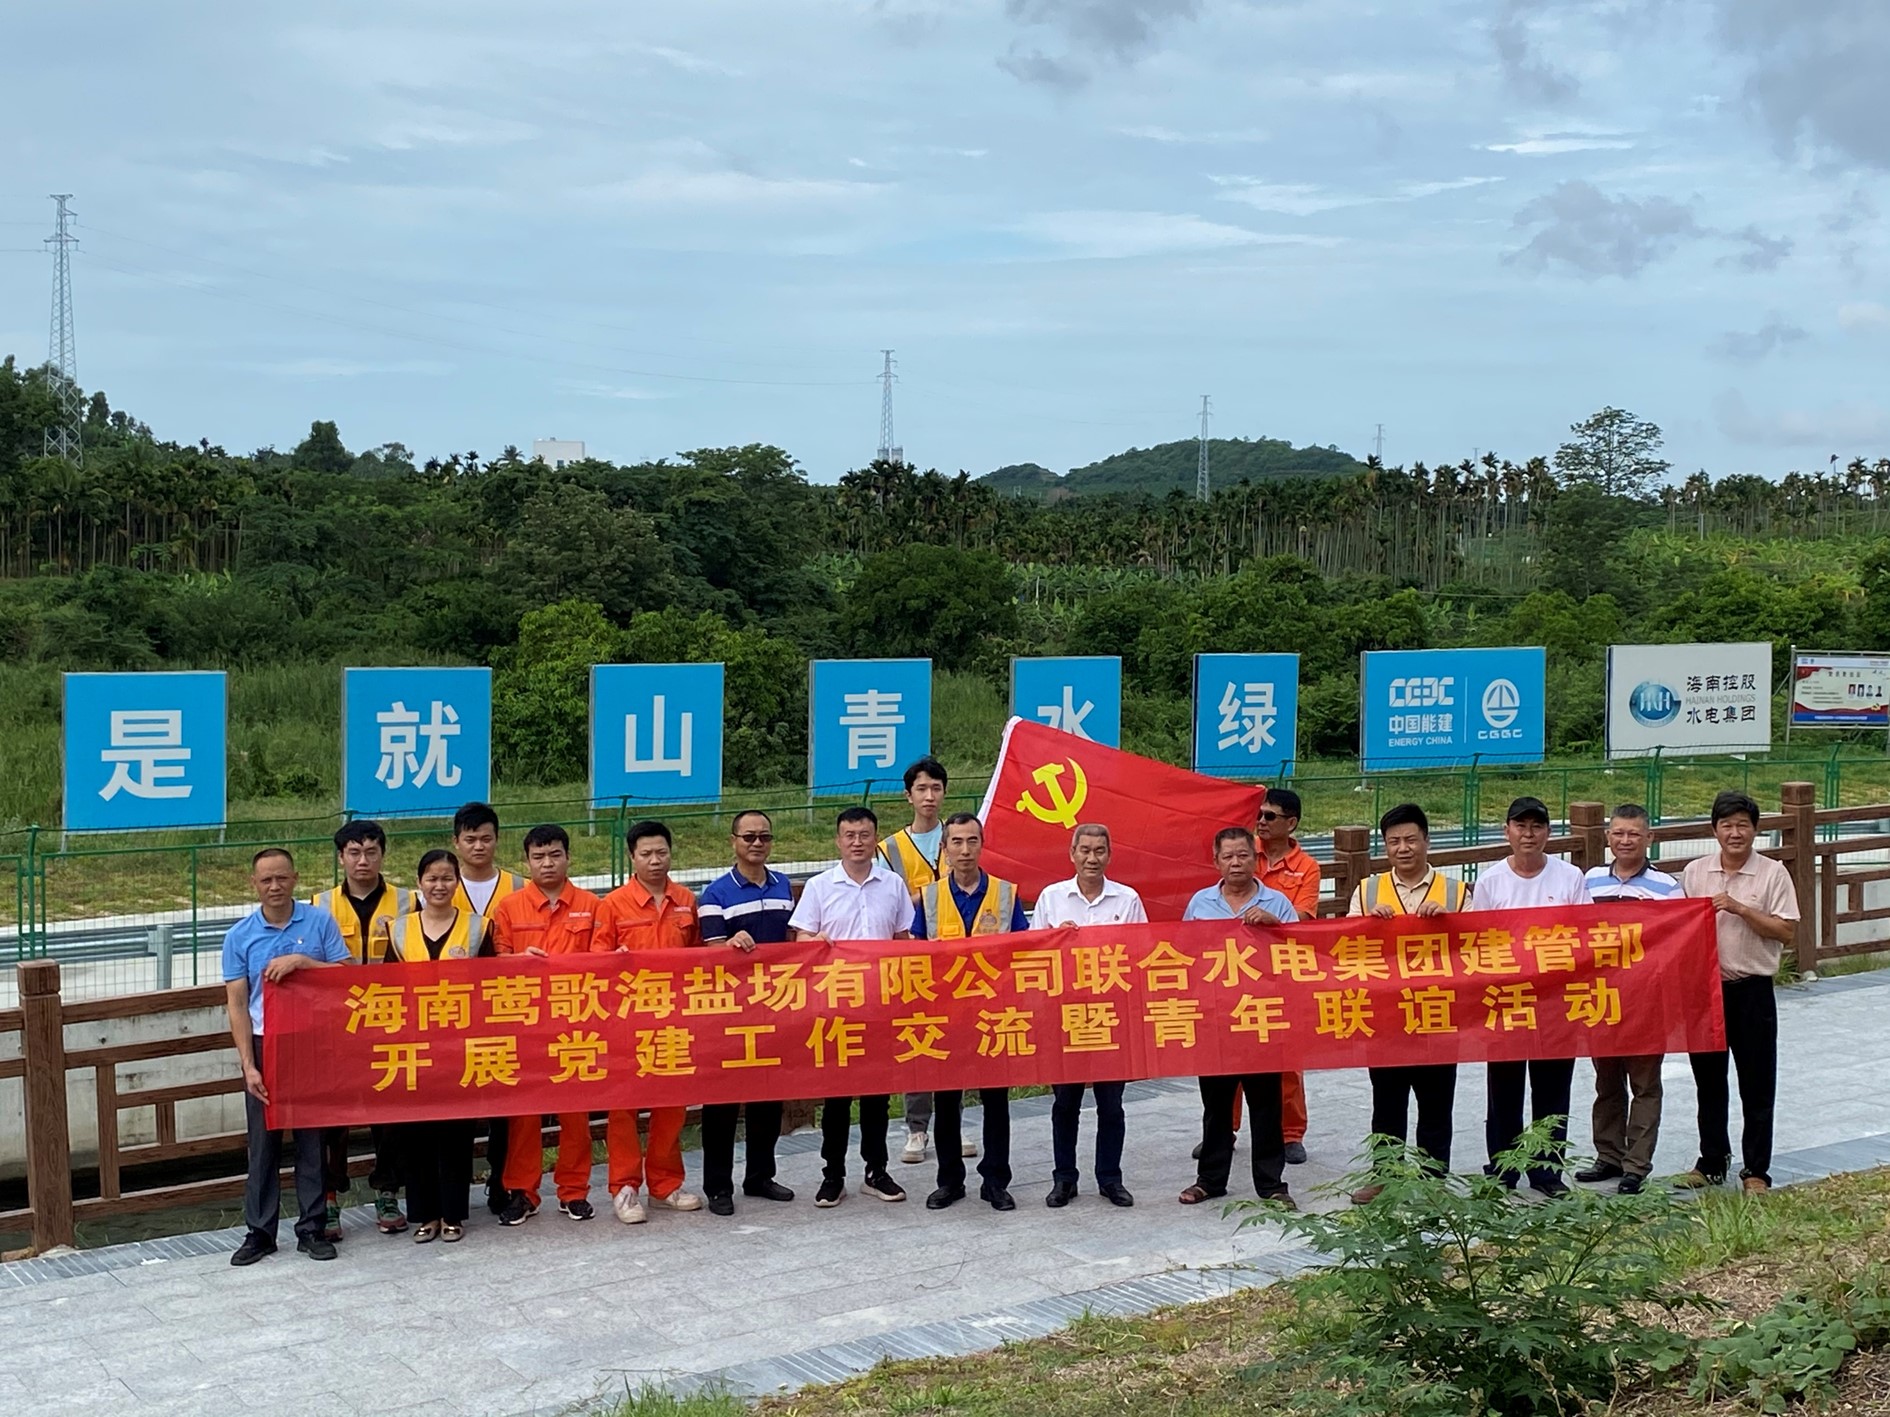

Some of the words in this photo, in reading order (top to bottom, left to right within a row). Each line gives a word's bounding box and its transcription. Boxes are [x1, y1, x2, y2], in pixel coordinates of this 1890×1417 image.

[1217, 681, 1278, 753] 绿
[1685, 695, 1715, 705] HAINAN
[1717, 693, 1756, 704] HOLDINGS
[1686, 674, 1756, 693] 海南控股
[1686, 705, 1756, 725] 水电集团
[99, 709, 193, 801] 是
[375, 700, 462, 789] 就
[624, 695, 693, 777] 山
[838, 689, 906, 770] 青
[1388, 713, 1453, 735] 中国能建
[1388, 737, 1423, 748] ENERGY
[1425, 736, 1453, 746] CHINA
[345, 921, 1646, 1034] 海南莺歌海盐场有限公司联合水电集团建管部
[371, 975, 1624, 1092] 开展党建工作交流暨青年联谊活动
